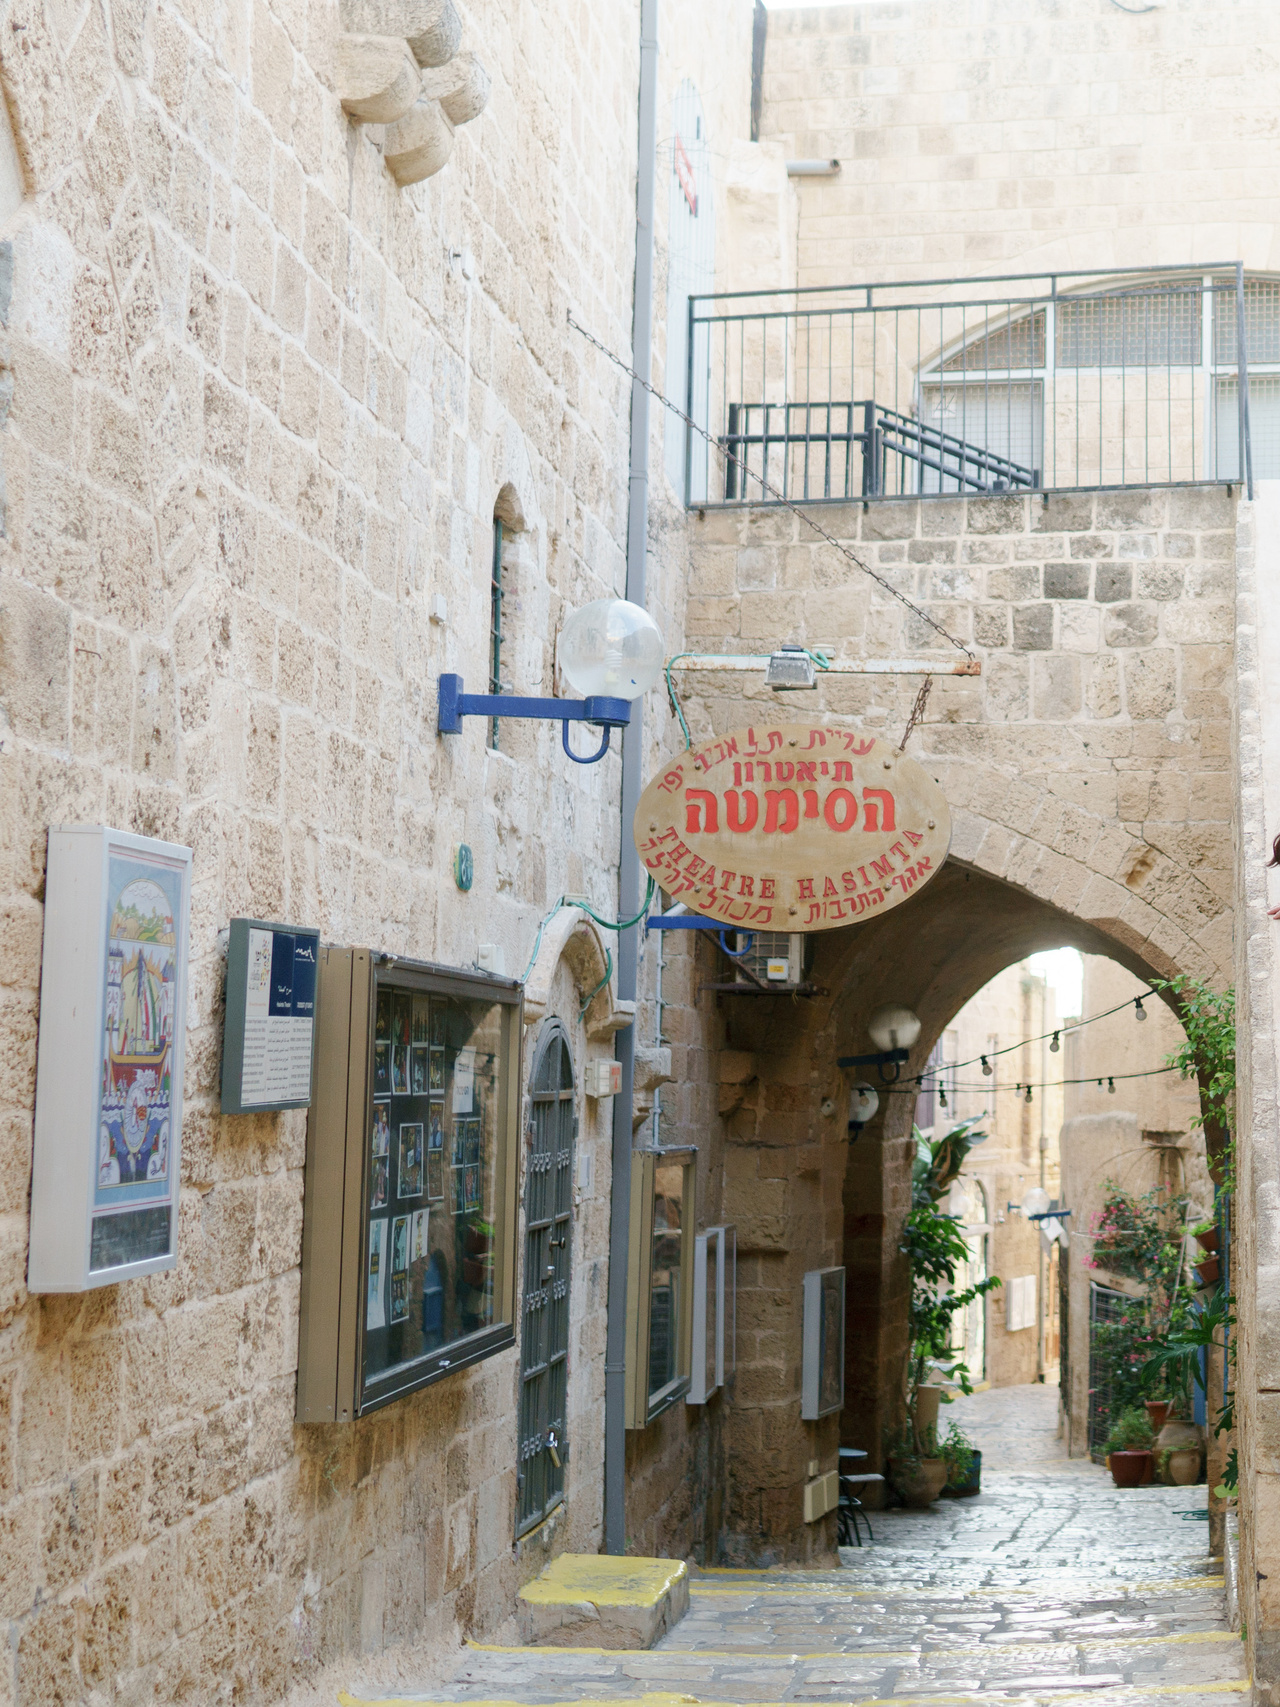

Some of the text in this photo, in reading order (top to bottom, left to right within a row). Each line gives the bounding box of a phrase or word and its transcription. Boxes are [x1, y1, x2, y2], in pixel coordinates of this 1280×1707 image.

[693, 736, 739, 775] אביב
[743, 727, 783, 758] תל
[657, 764, 684, 794] יפו
[732, 761, 854, 787] תיאטרון
[685, 787, 897, 835] הסימטה
[639, 837, 934, 925] אגף התרבות מנהל קהילה
[656, 826, 924, 900] THEATRE HASIMTA
